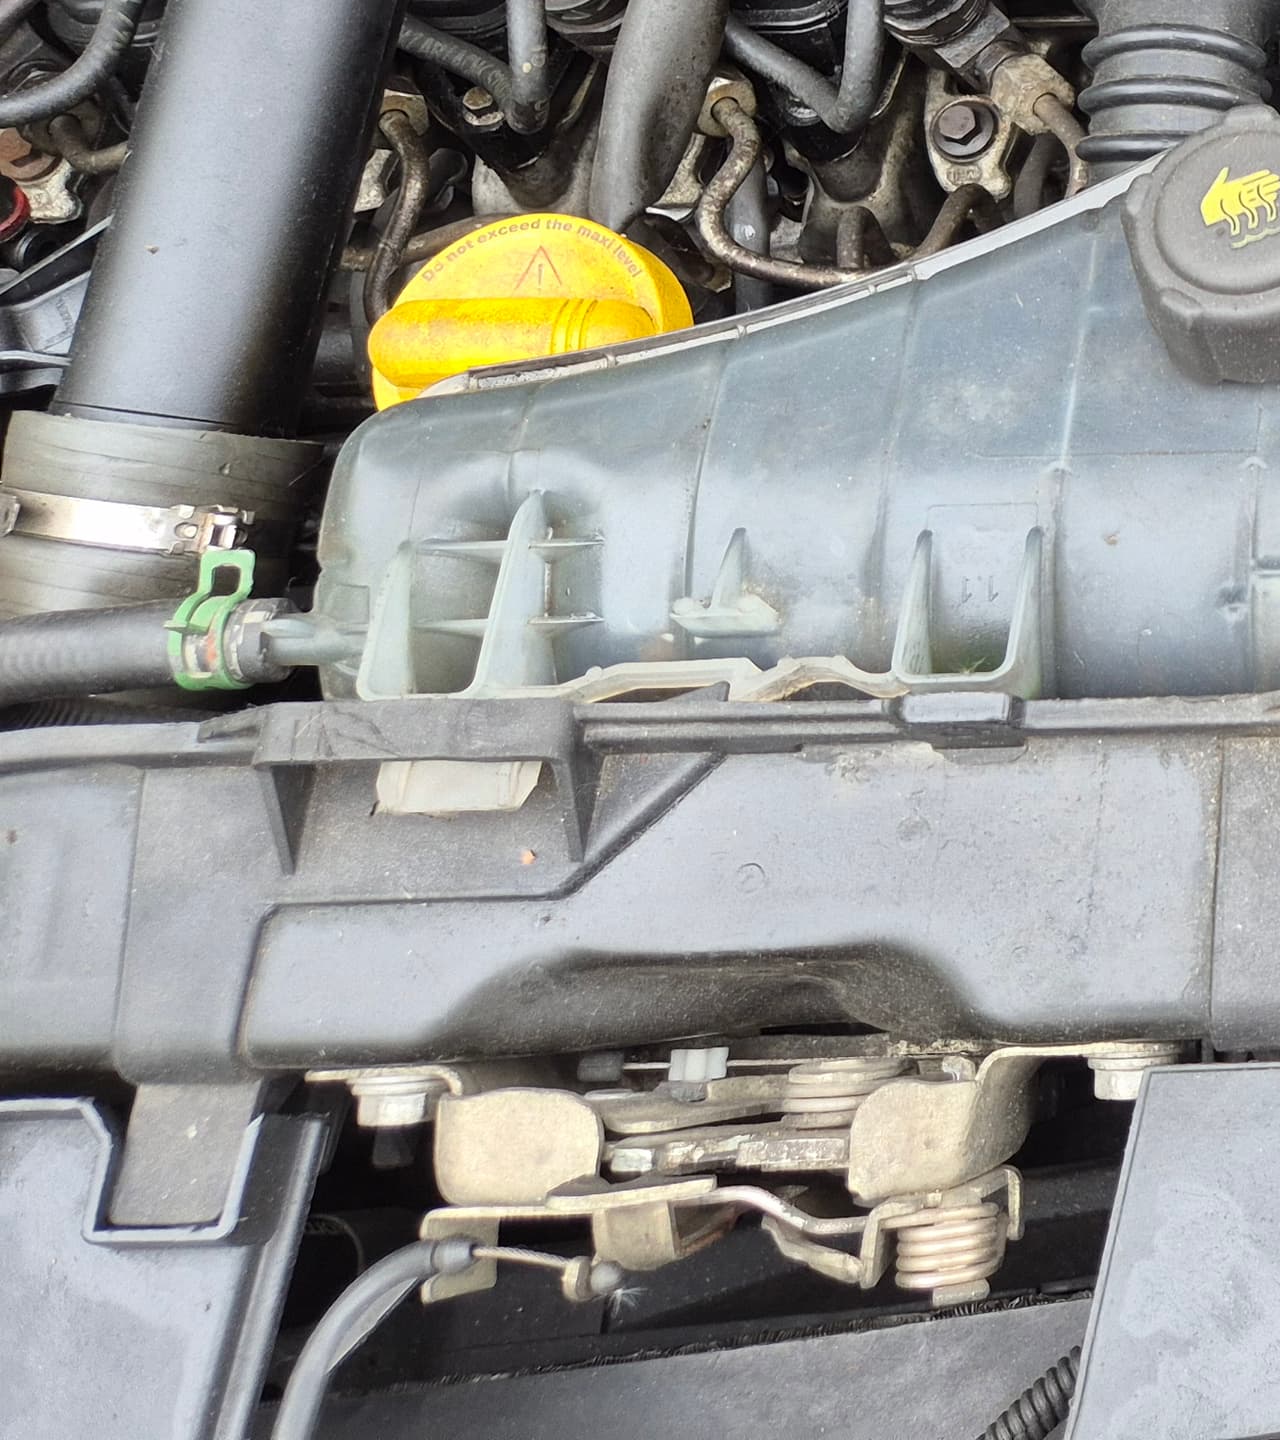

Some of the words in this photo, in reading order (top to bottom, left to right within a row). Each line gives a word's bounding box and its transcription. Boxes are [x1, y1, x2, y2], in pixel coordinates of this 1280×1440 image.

[421, 263, 445, 283] Do
[448, 239, 474, 262] not
[478, 219, 541, 244] exceed
[546, 219, 573, 232] the
[576, 224, 614, 249] maxi
[612, 242, 643, 278] level
